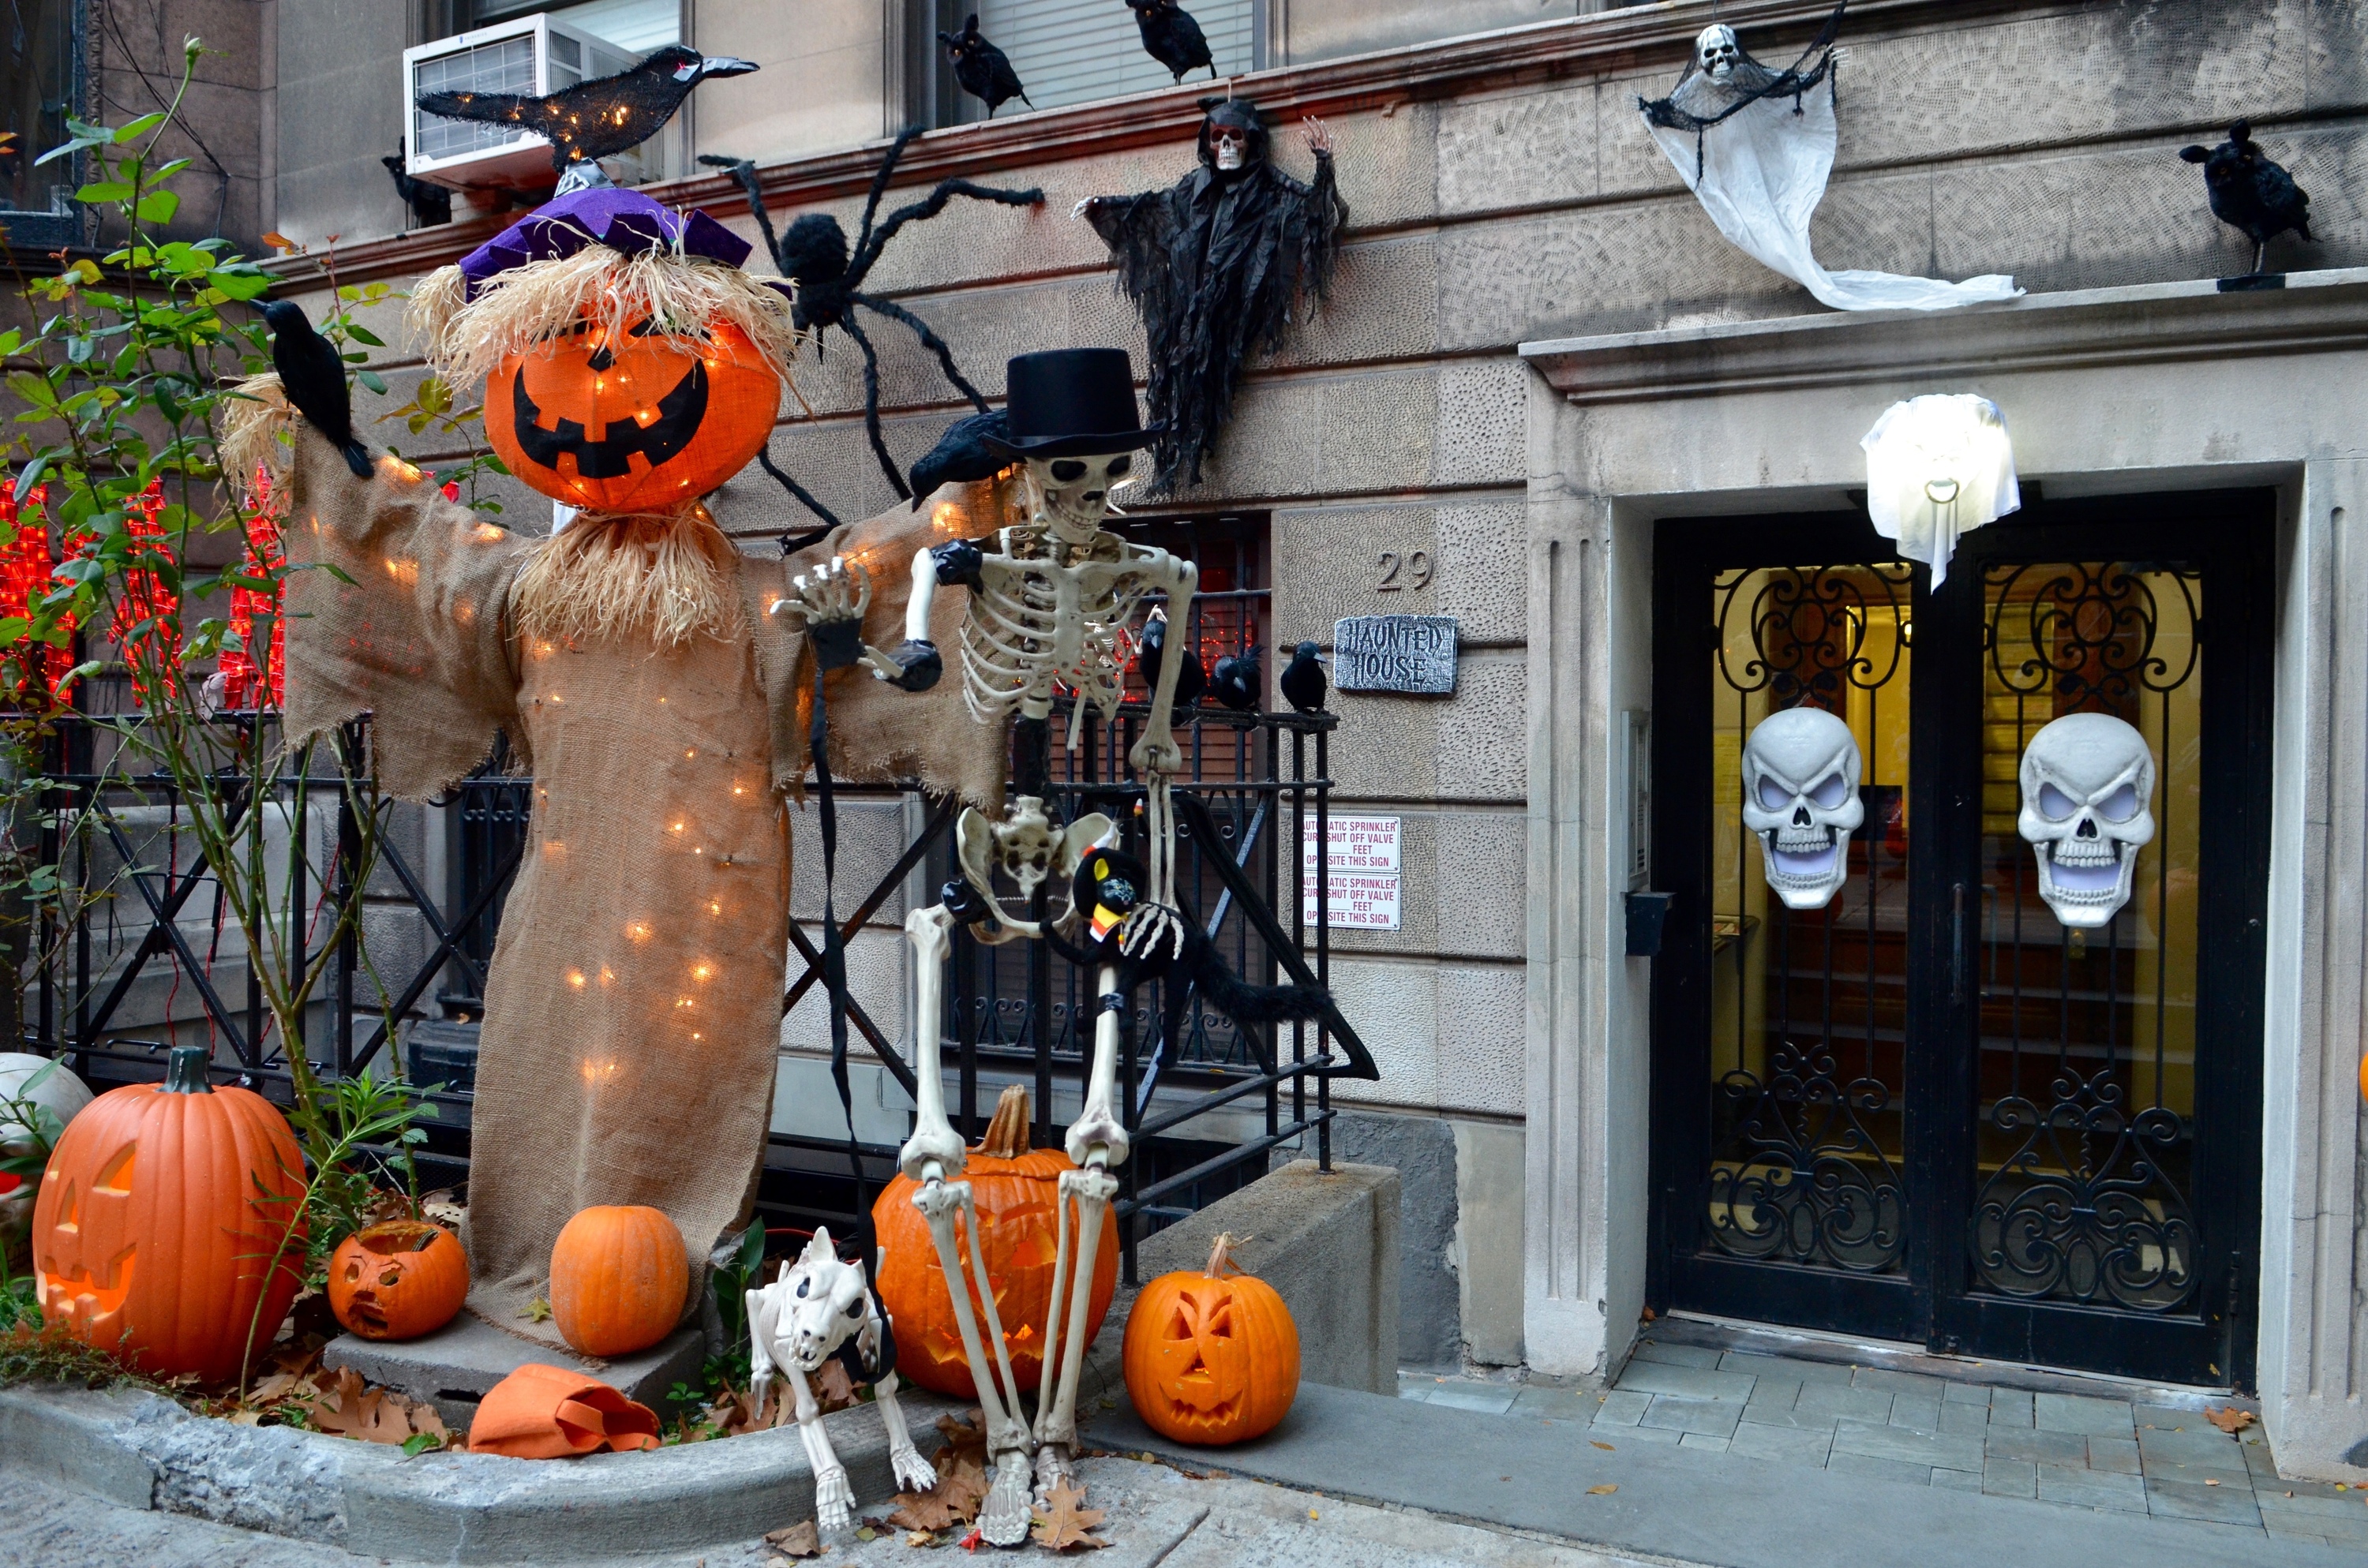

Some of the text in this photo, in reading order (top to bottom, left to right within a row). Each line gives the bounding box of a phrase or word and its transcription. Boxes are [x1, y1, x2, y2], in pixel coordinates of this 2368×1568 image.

[1377, 550, 1433, 591] 29
[1347, 622, 1443, 657] HAUNTED
[1351, 652, 1428, 686] HOUSE
[1350, 821, 1396, 832] SPRINKLER
[1303, 832, 1394, 844] CUR SHUT OFF VALVE
[1353, 845, 1373, 855] FEET
[1306, 855, 1389, 866] OPSITE THIS SIGN
[1350, 878, 1396, 889] SPRINKLER
[1303, 888, 1394, 901] CUR SHUT OFF VALVE
[1353, 901, 1373, 911] FEET
[1306, 911, 1389, 924] OPSITE THIS SIGN
